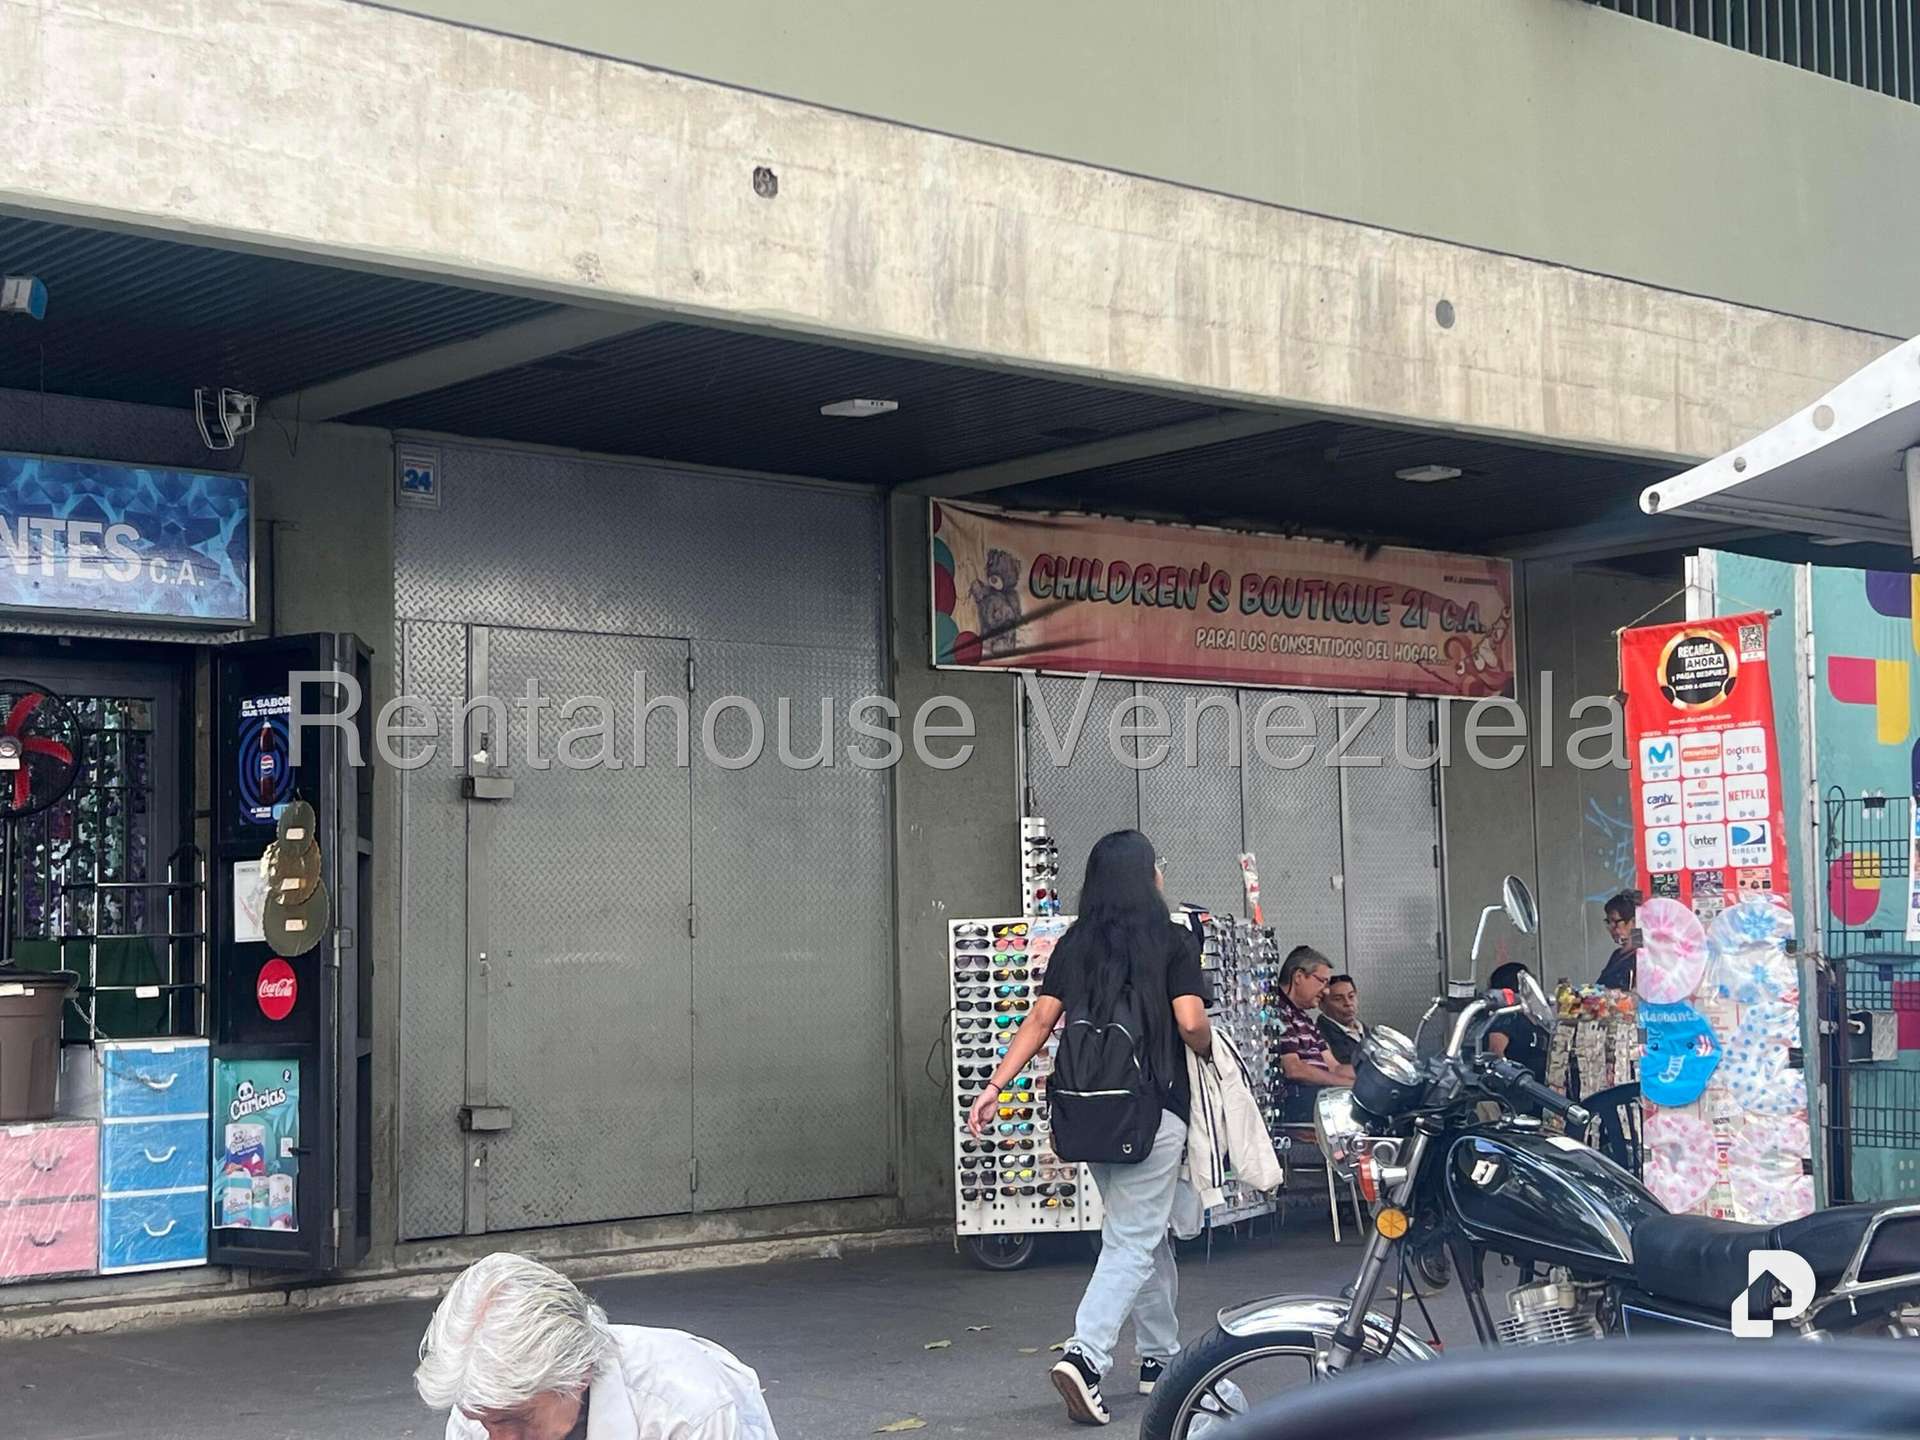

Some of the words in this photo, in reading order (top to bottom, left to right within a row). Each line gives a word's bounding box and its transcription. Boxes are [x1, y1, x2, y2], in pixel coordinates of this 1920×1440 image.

[405, 468, 432, 491] 24
[150, 557, 205, 587] C.A.
[1029, 553, 1231, 612] CHILDREN'S
[1240, 573, 1393, 625] BOUTIQUE
[1440, 599, 1486, 634] C.A.
[1196, 626, 1236, 650] PARA
[1241, 631, 1266, 652] LOS
[1270, 633, 1362, 659] CONSENTIDOS
[1367, 639, 1389, 661] DEL
[1687, 656, 1722, 669] AHORA
[242, 700, 255, 710] EL
[256, 696, 291, 708] SABOR
[1728, 789, 1766, 801] NETFLIX
[1694, 835, 1718, 846] inter
[1732, 847, 1767, 855] DIRECTV
[230, 1087, 286, 1121] Caricias
